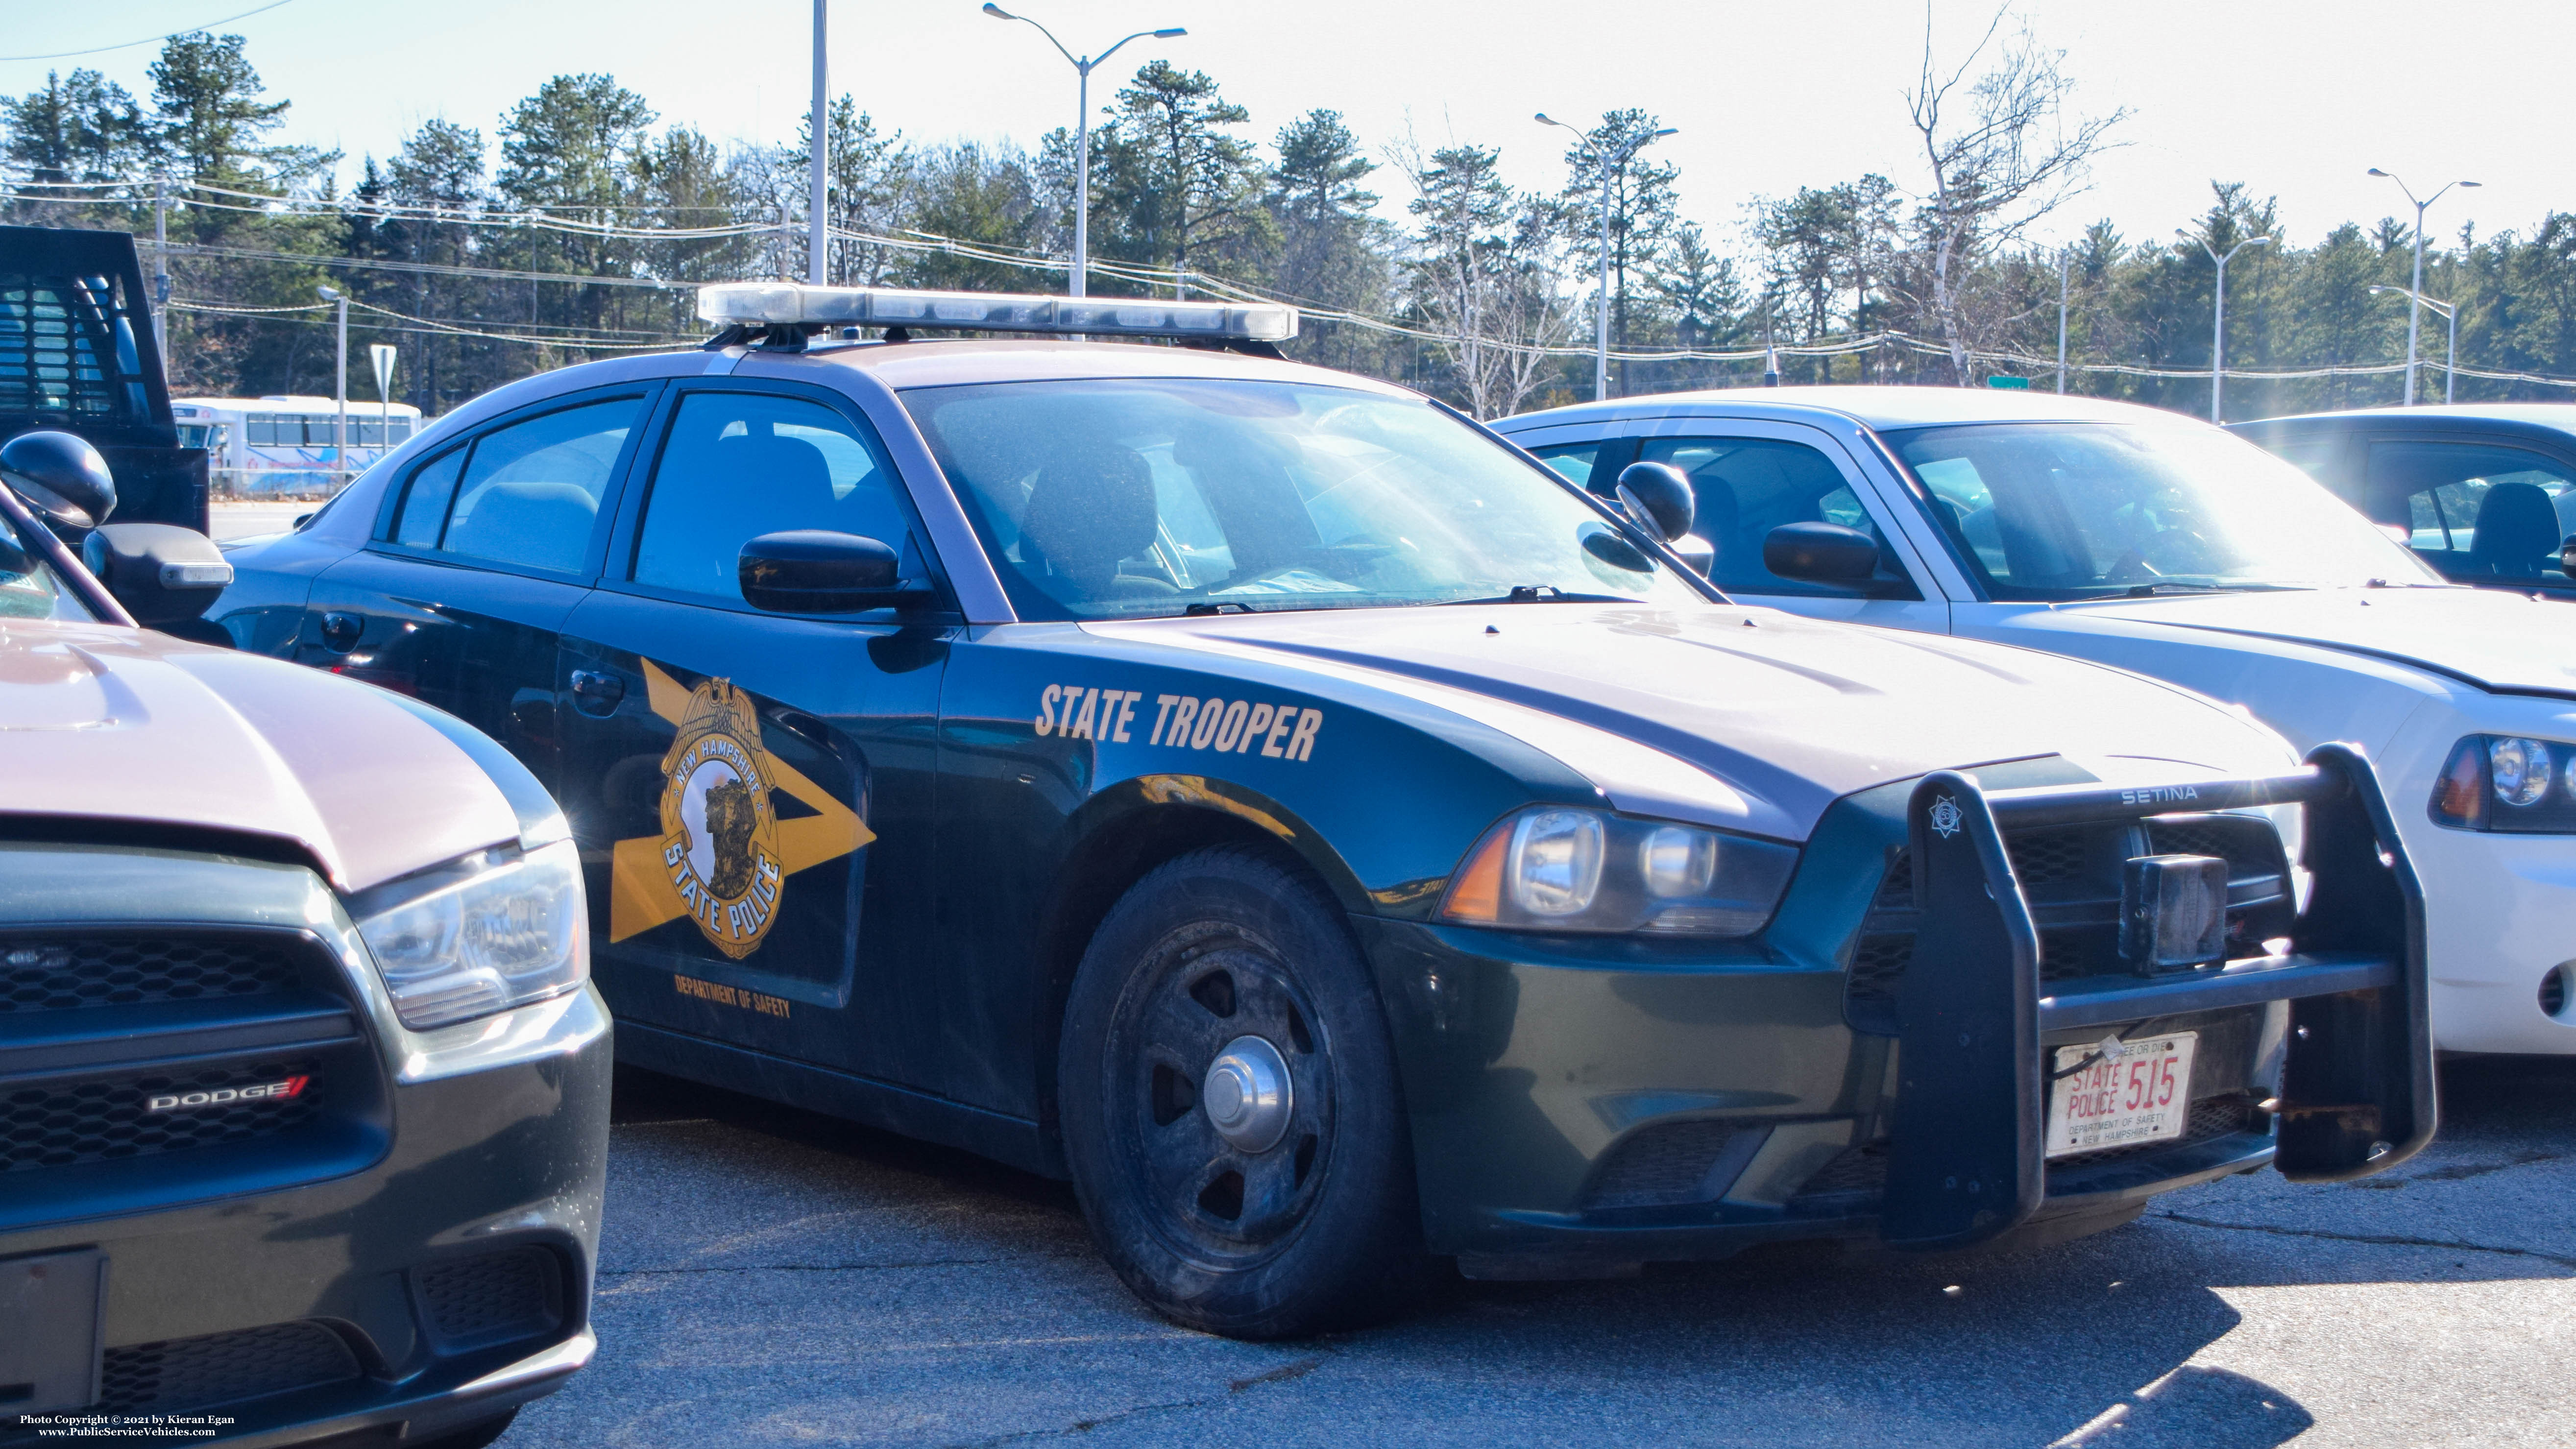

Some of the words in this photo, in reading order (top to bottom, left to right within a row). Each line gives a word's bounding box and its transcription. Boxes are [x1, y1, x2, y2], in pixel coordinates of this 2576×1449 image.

[1035, 684, 1142, 743] STATE
[1149, 694, 1323, 762] TROOPER
[676, 749, 697, 785] NEW
[702, 739, 760, 796] HAMPSHIRE
[2121, 786, 2198, 804] SETINA
[665, 842, 722, 933] STATE
[728, 853, 780, 939] POLICE
[674, 974, 737, 1005] DEPARTMENT
[738, 989, 751, 1009] OF
[753, 992, 790, 1018] SAFETY
[2137, 1044, 2149, 1055] OR
[2151, 1042, 2166, 1053] DIE
[150, 1082, 291, 1110] DODGE
[2072, 1063, 2121, 1092] STATE
[2126, 1056, 2178, 1111] 515
[2067, 1089, 2118, 1120] POLICE
[2069, 1119, 2119, 1135] DEPARTMENT
[2122, 1117, 2133, 1127] OF
[2136, 1112, 2166, 1125] SAFETY
[2082, 1134, 2100, 1145] NEW
[2104, 1127, 2149, 1141] HAMPSHIRE
